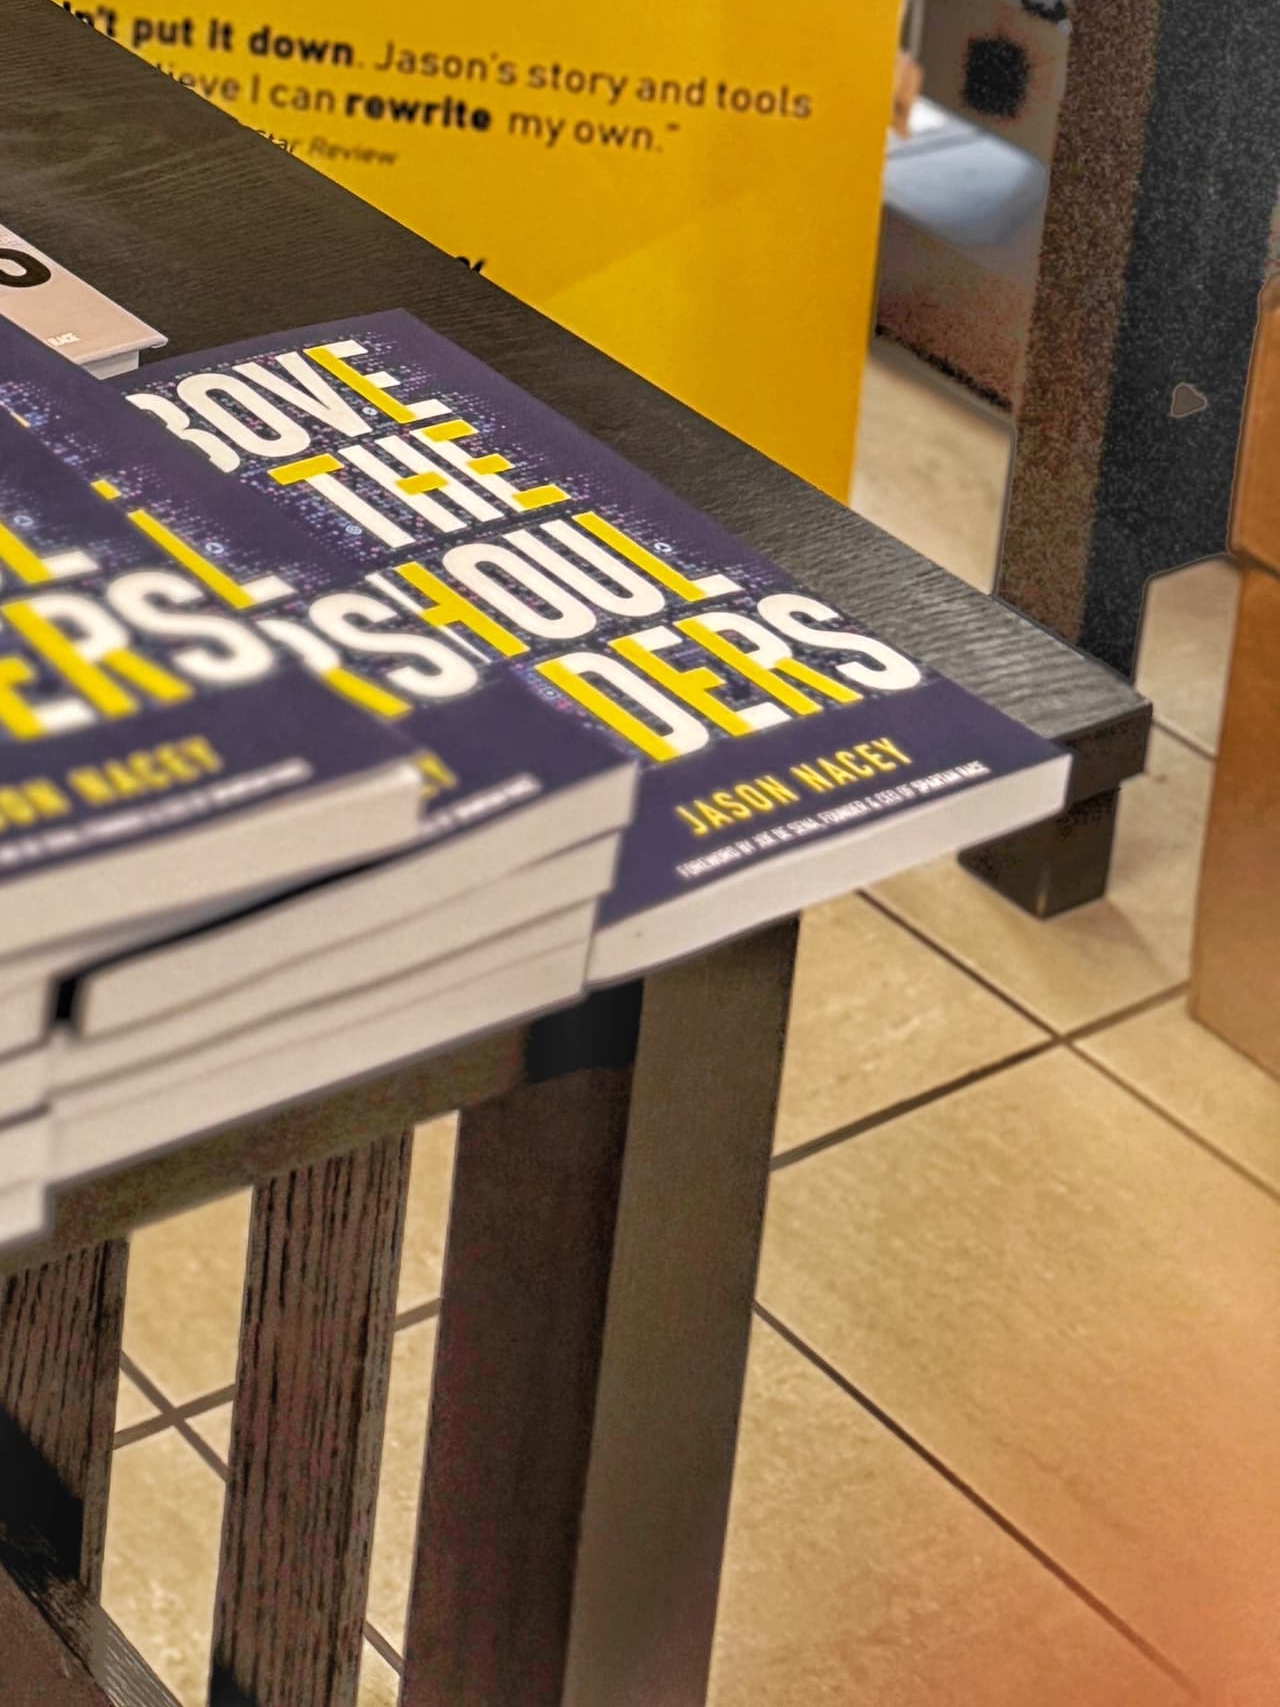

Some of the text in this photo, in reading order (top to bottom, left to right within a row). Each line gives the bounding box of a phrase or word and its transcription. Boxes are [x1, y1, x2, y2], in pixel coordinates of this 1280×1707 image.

[132, 17, 195, 48] put
[207, 19, 235, 52] it
[248, 25, 364, 68] down.
[528, 63, 629, 106] story
[635, 76, 708, 108] and
[715, 81, 812, 120] tools
[251, 74, 261, 105] I
[269, 84, 336, 113] can
[344, 92, 494, 134] rewrite
[508, 112, 571, 151] my
[267, 419, 572, 549] THE
[534, 593, 922, 763] DERS
[80, 733, 224, 804] NACEY
[674, 736, 912, 836] JASON NACEY
